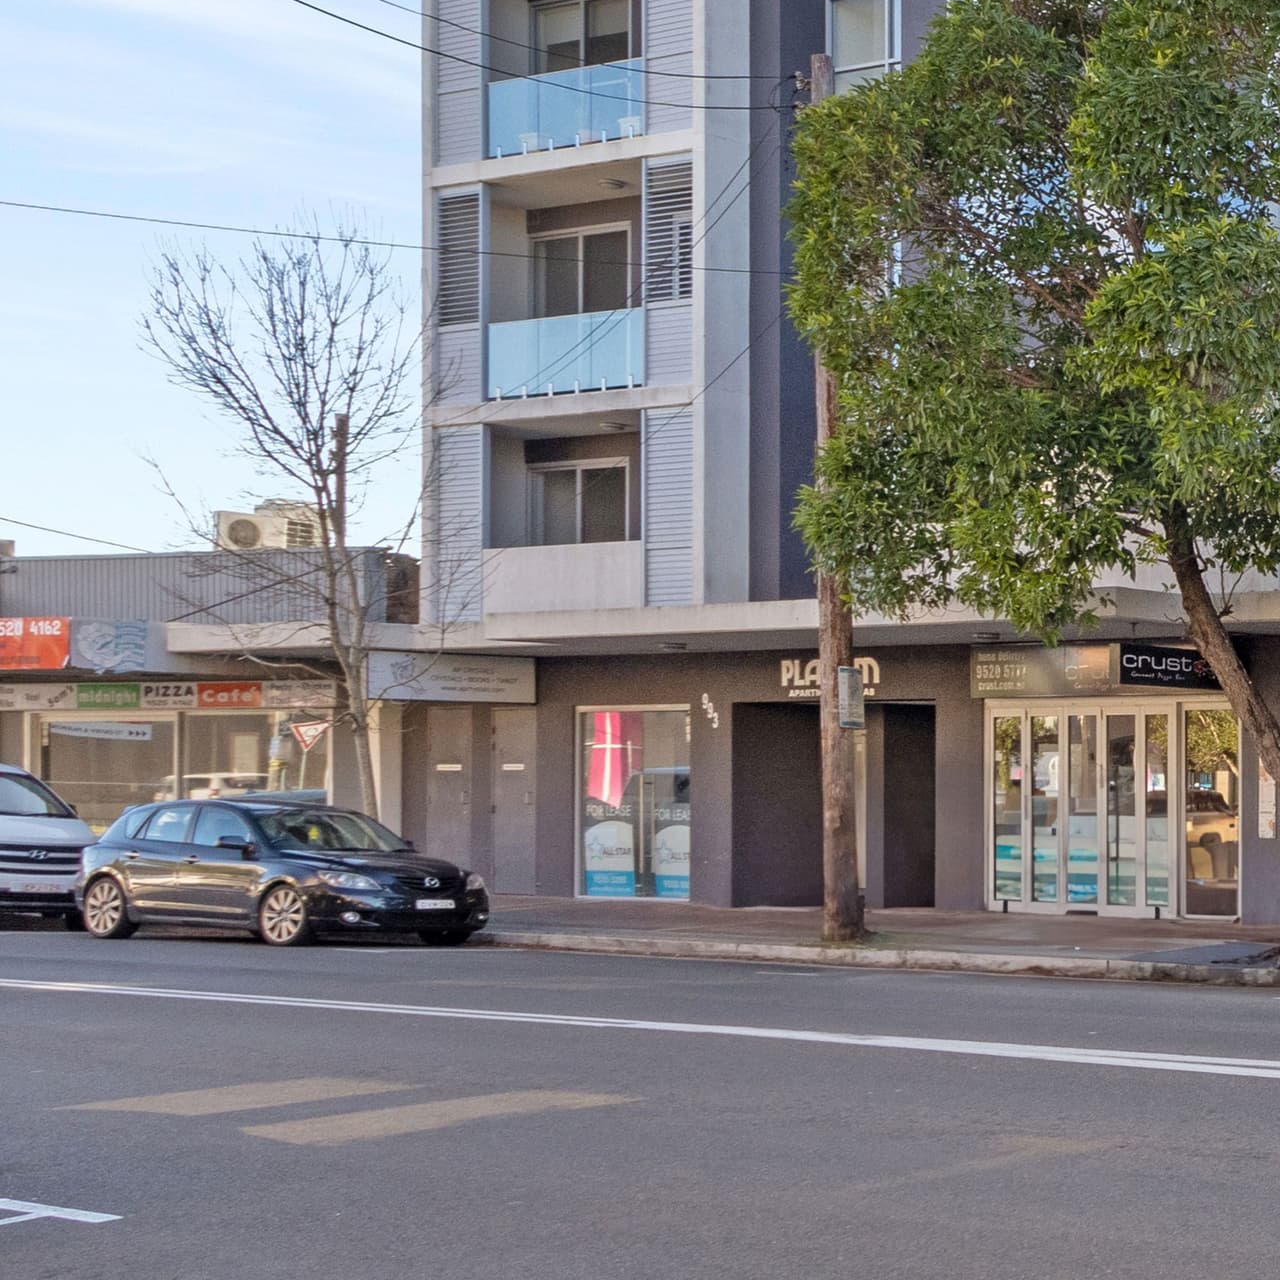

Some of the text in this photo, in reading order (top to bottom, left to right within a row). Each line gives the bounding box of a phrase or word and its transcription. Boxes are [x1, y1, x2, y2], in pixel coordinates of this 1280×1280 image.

[30, 620, 61, 636] 4162
[1123, 654, 1192, 672] crust
[976, 664, 1001, 679] 9520
[79, 690, 137, 706] midnight
[144, 685, 194, 697] PIZZA
[586, 805, 604, 816] FOR
